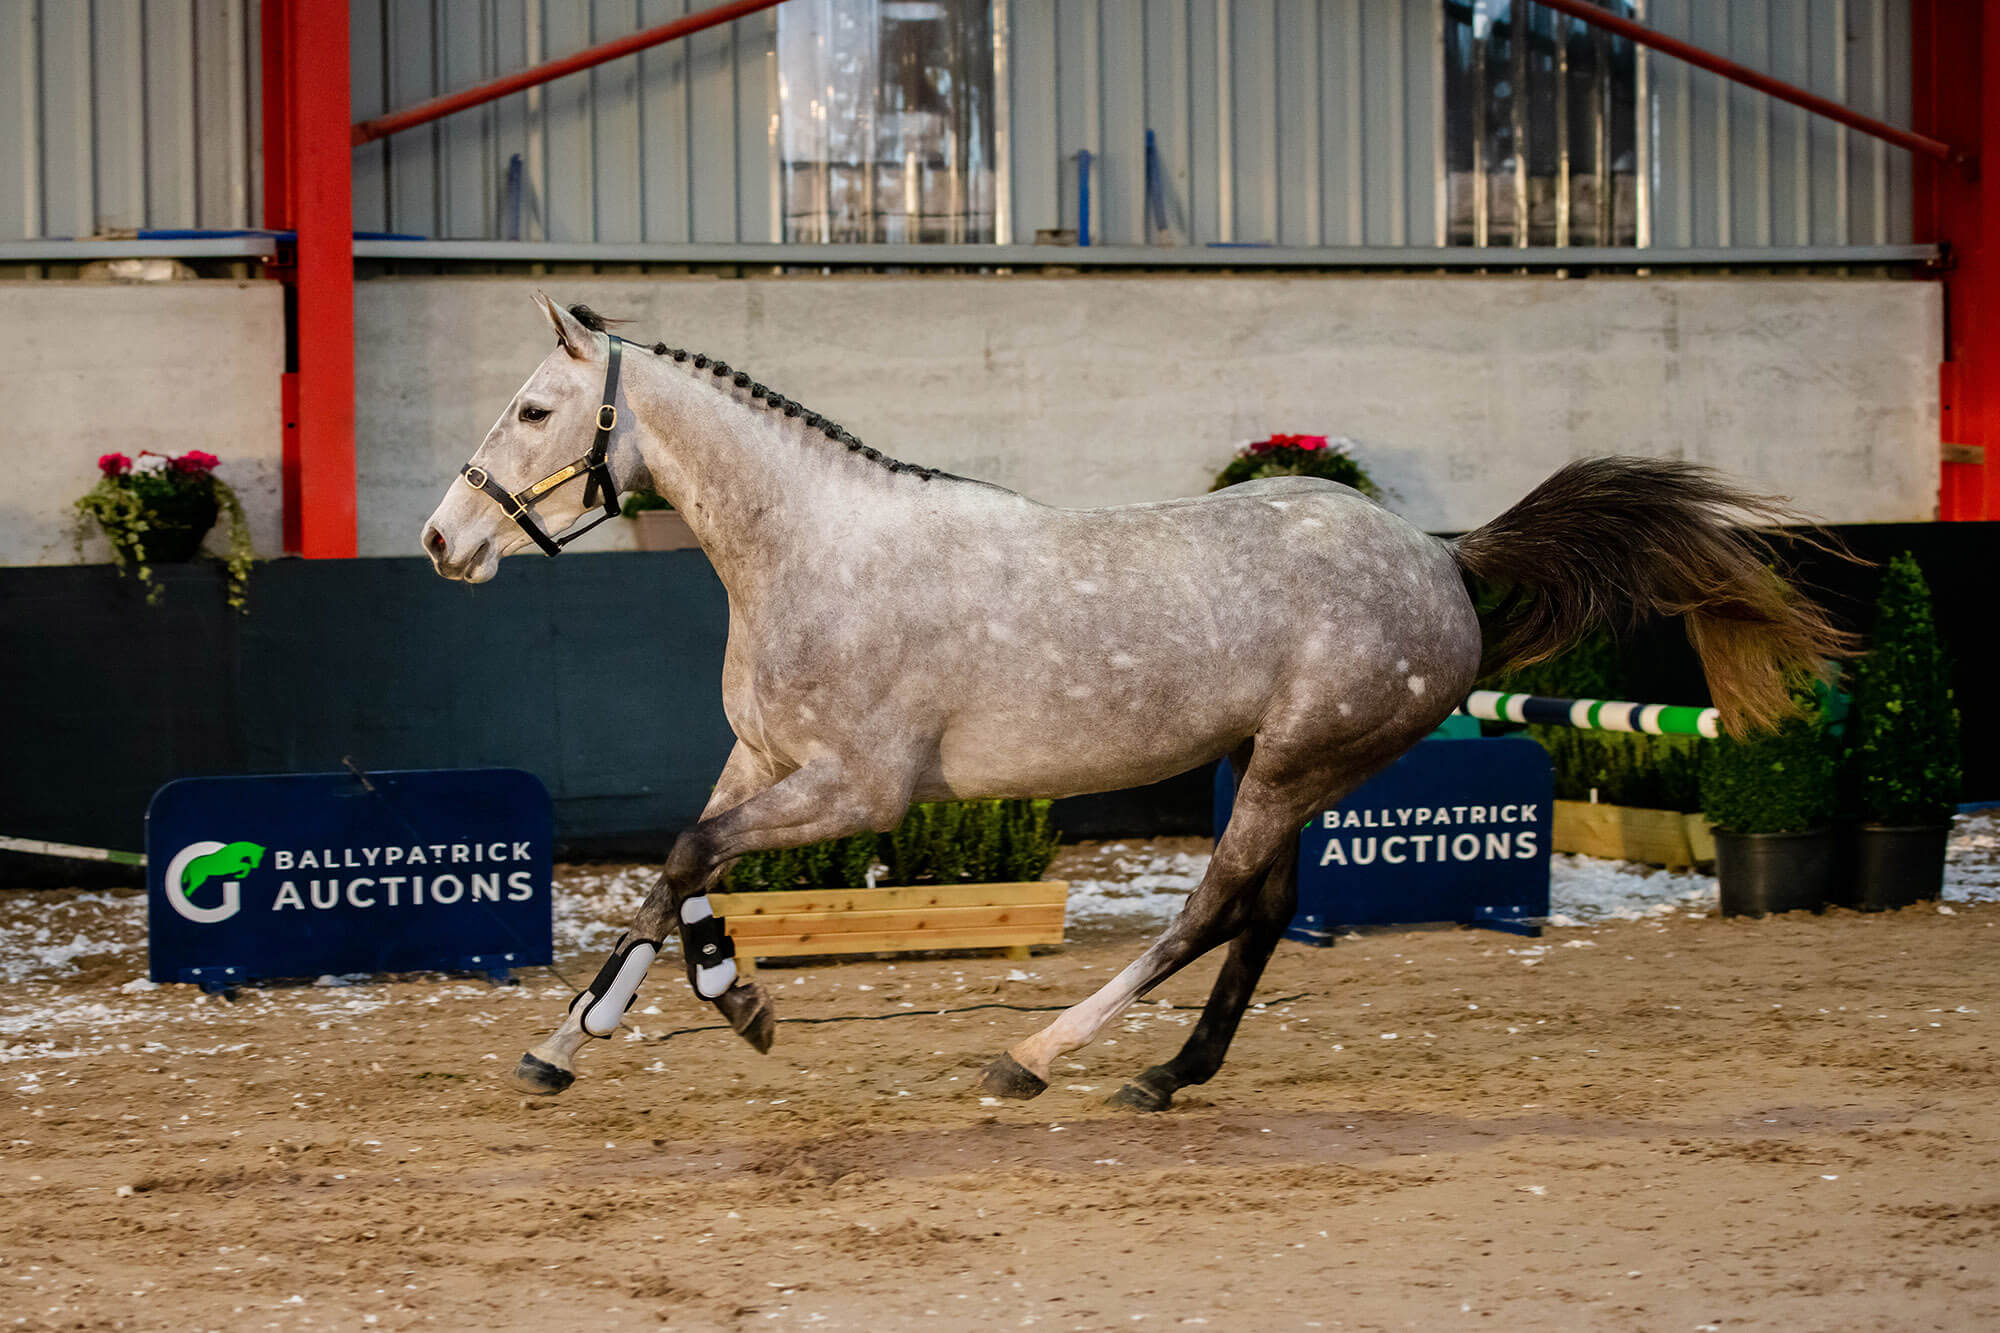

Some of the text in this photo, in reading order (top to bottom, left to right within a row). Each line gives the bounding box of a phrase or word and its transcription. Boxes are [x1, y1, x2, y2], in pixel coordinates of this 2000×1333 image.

[1323, 804, 1537, 828] BALLYPATRICK
[275, 841, 531, 869] BALLYPATRICK
[1319, 832, 1538, 866] AUCTIONS
[272, 871, 533, 910] AUCTIONS
